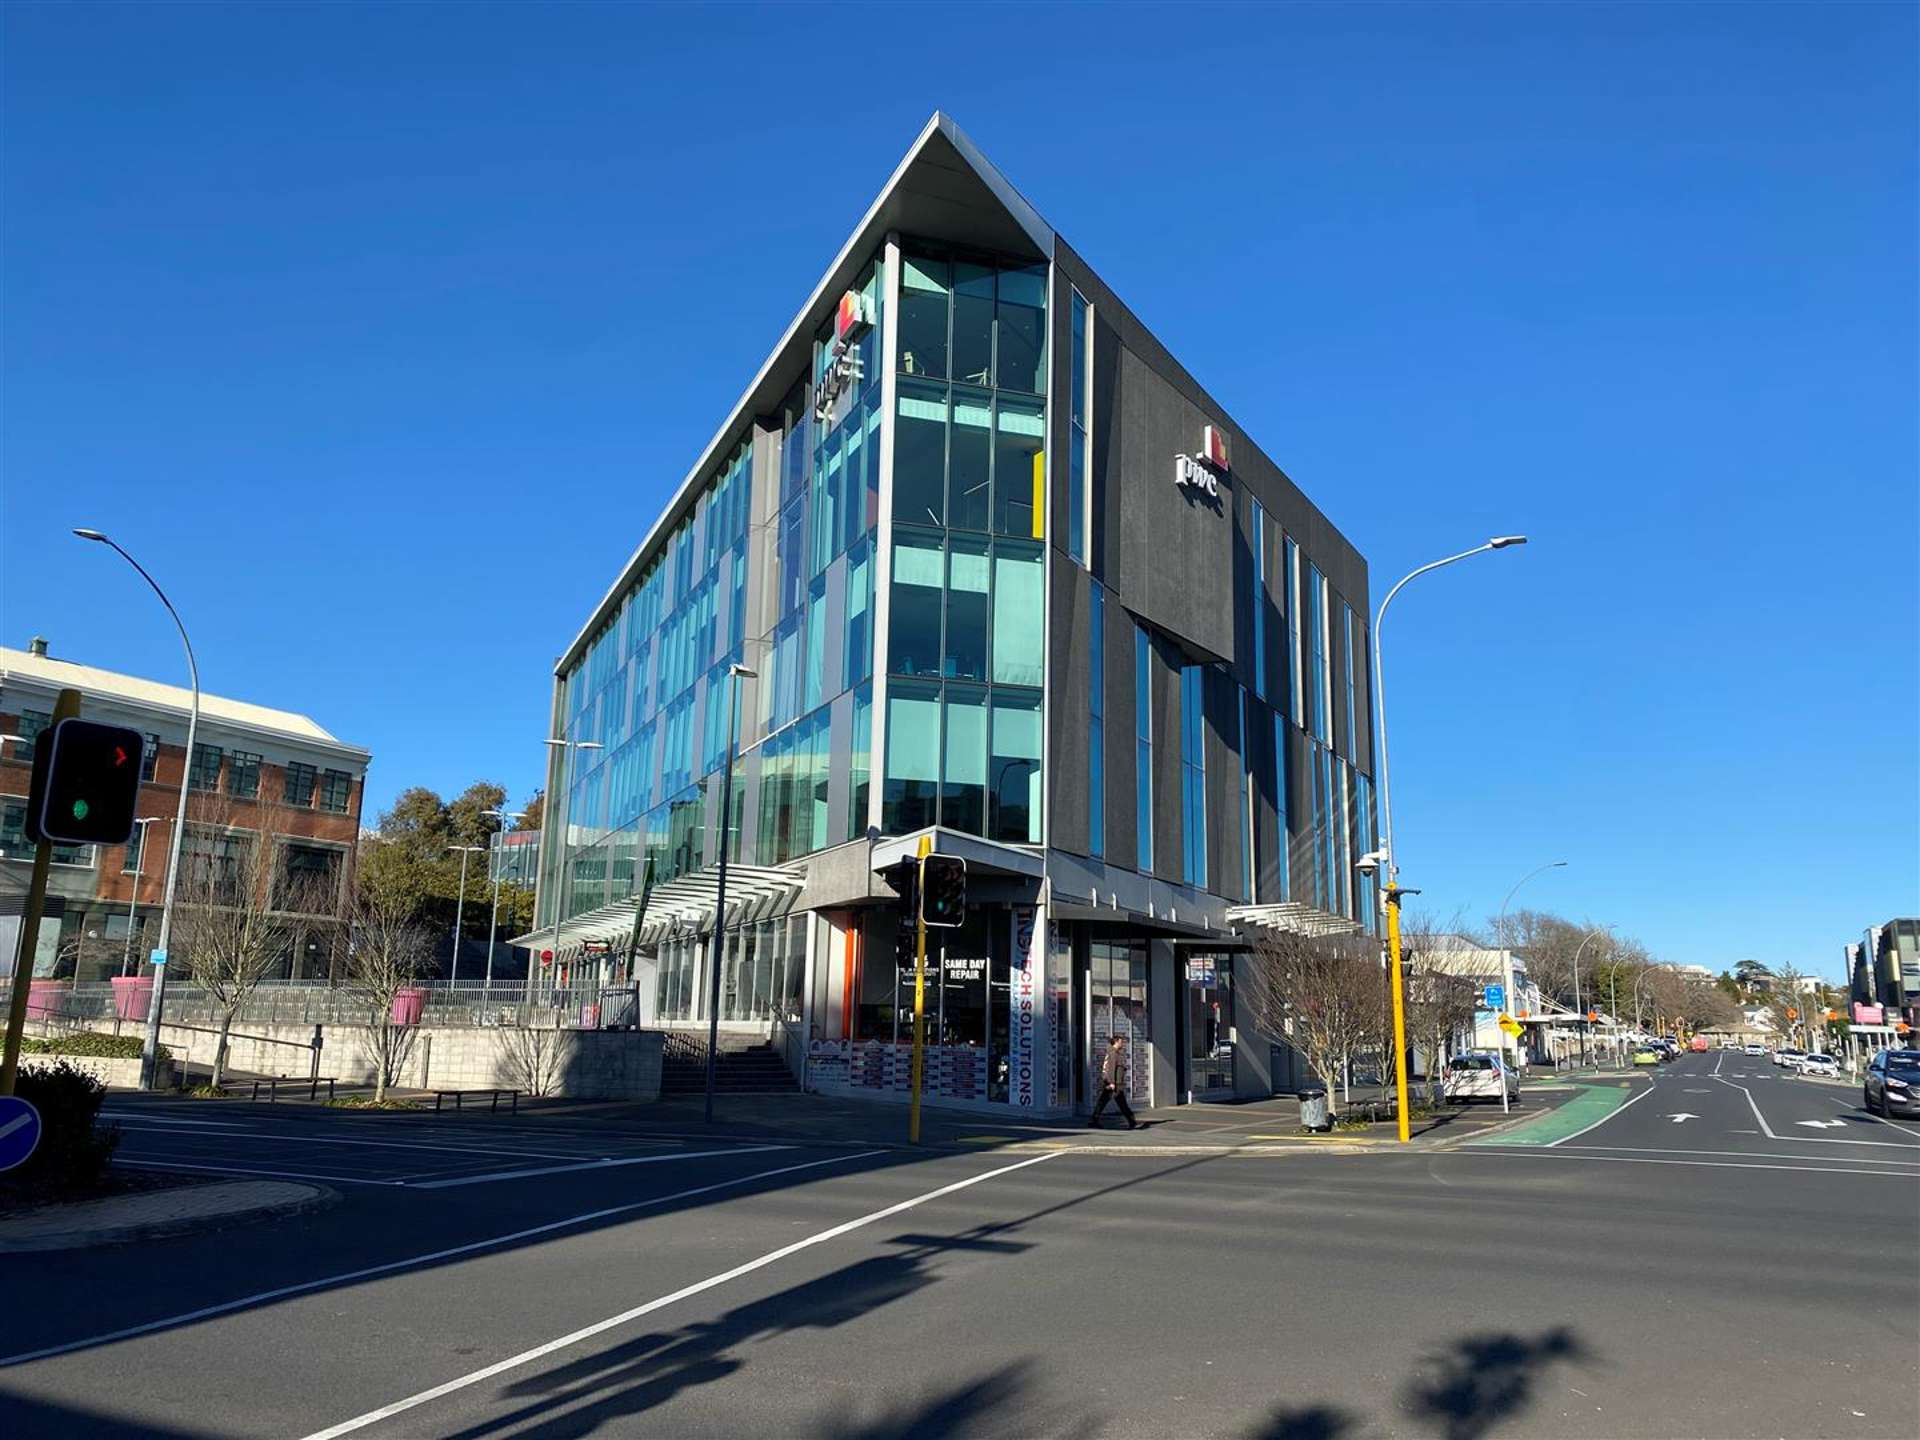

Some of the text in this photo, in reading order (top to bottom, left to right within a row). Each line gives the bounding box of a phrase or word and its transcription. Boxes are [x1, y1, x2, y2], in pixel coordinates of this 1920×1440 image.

[1175, 454, 1217, 496] pwc
[945, 959, 986, 969] SAME DAY
[950, 969, 980, 979] REPAIR
[1020, 1000, 1032, 1106] SOLUTIONS
